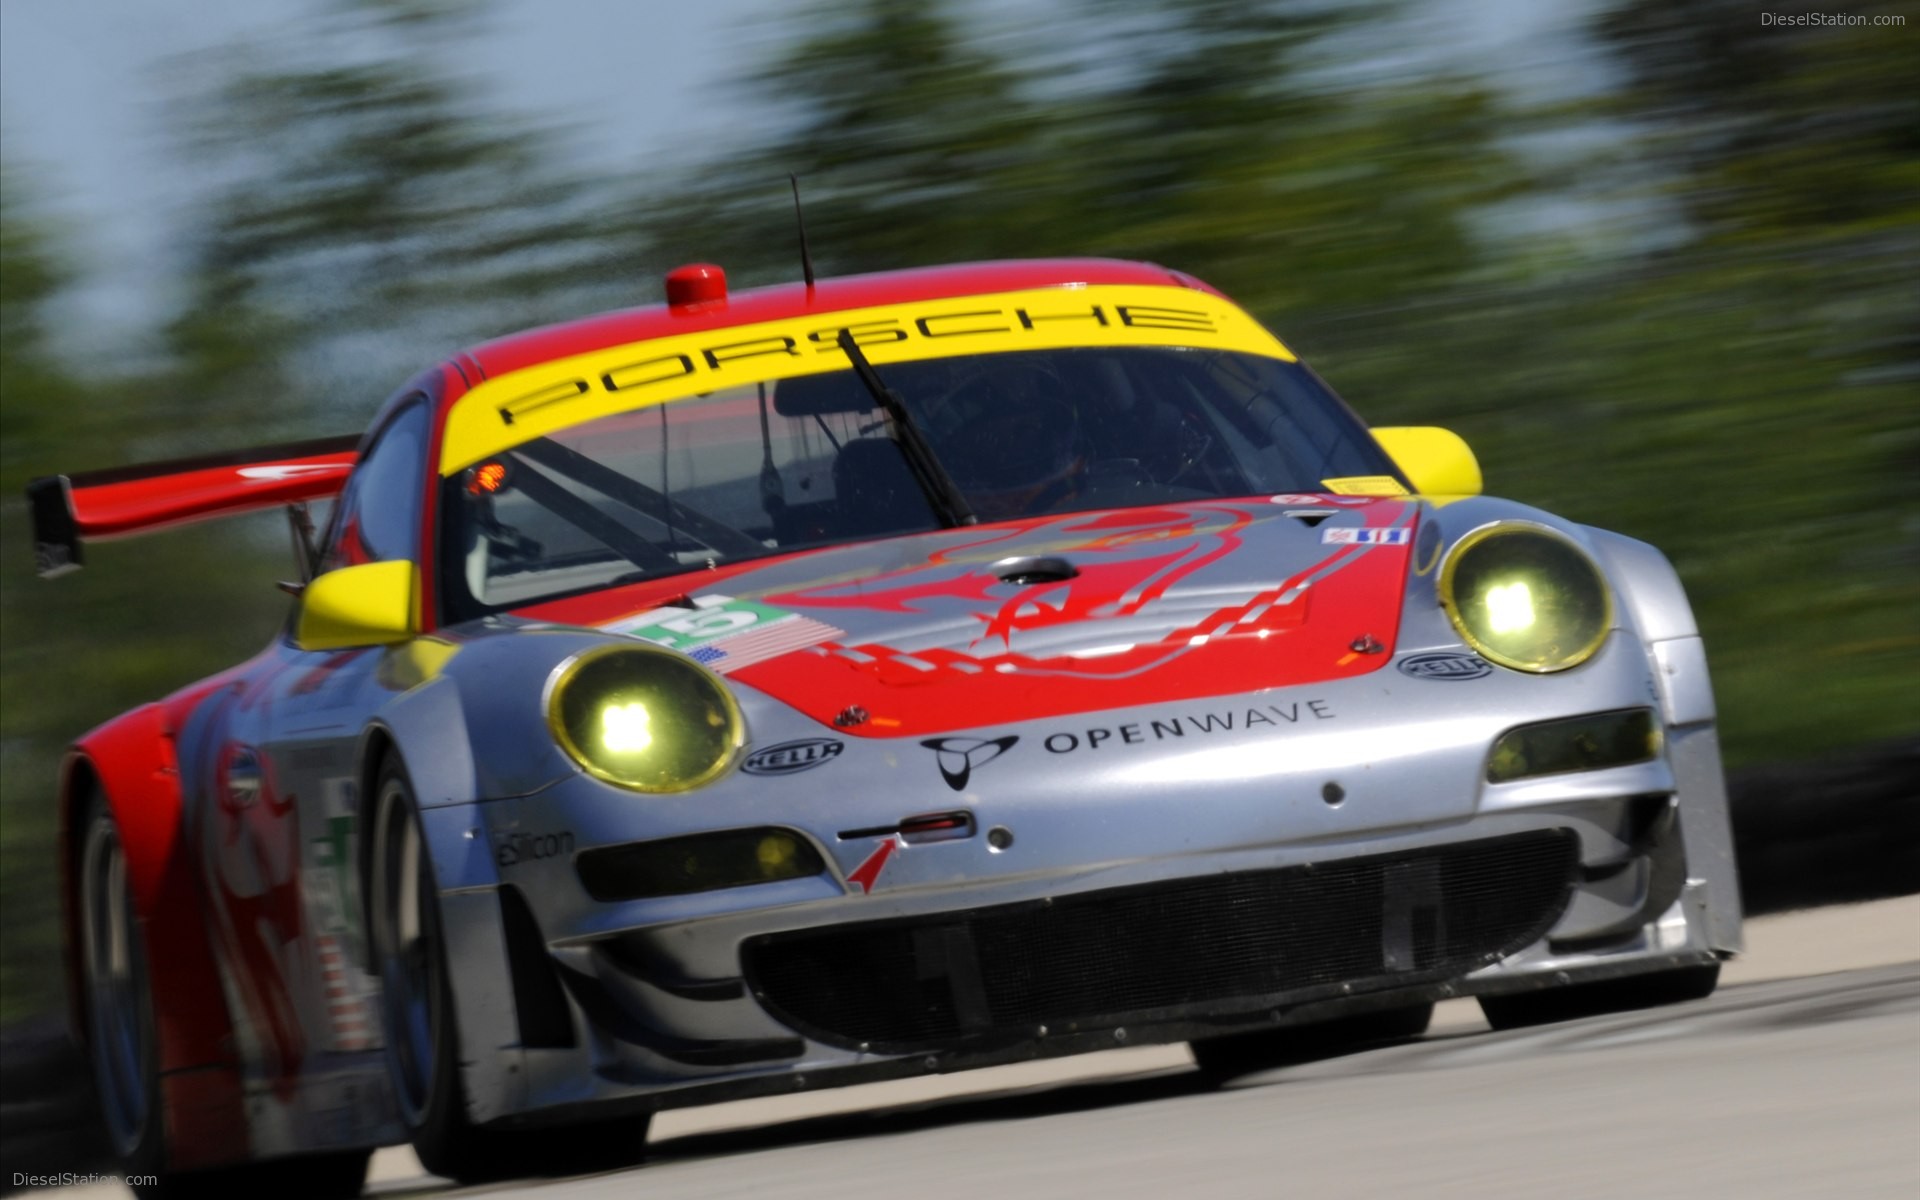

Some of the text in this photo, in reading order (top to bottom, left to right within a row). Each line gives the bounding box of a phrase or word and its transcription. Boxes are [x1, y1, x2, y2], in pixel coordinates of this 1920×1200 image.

[498, 304, 1218, 425] PORSCHE
[1043, 699, 1337, 754] OPENWAVE
[743, 739, 845, 772] HELLA
